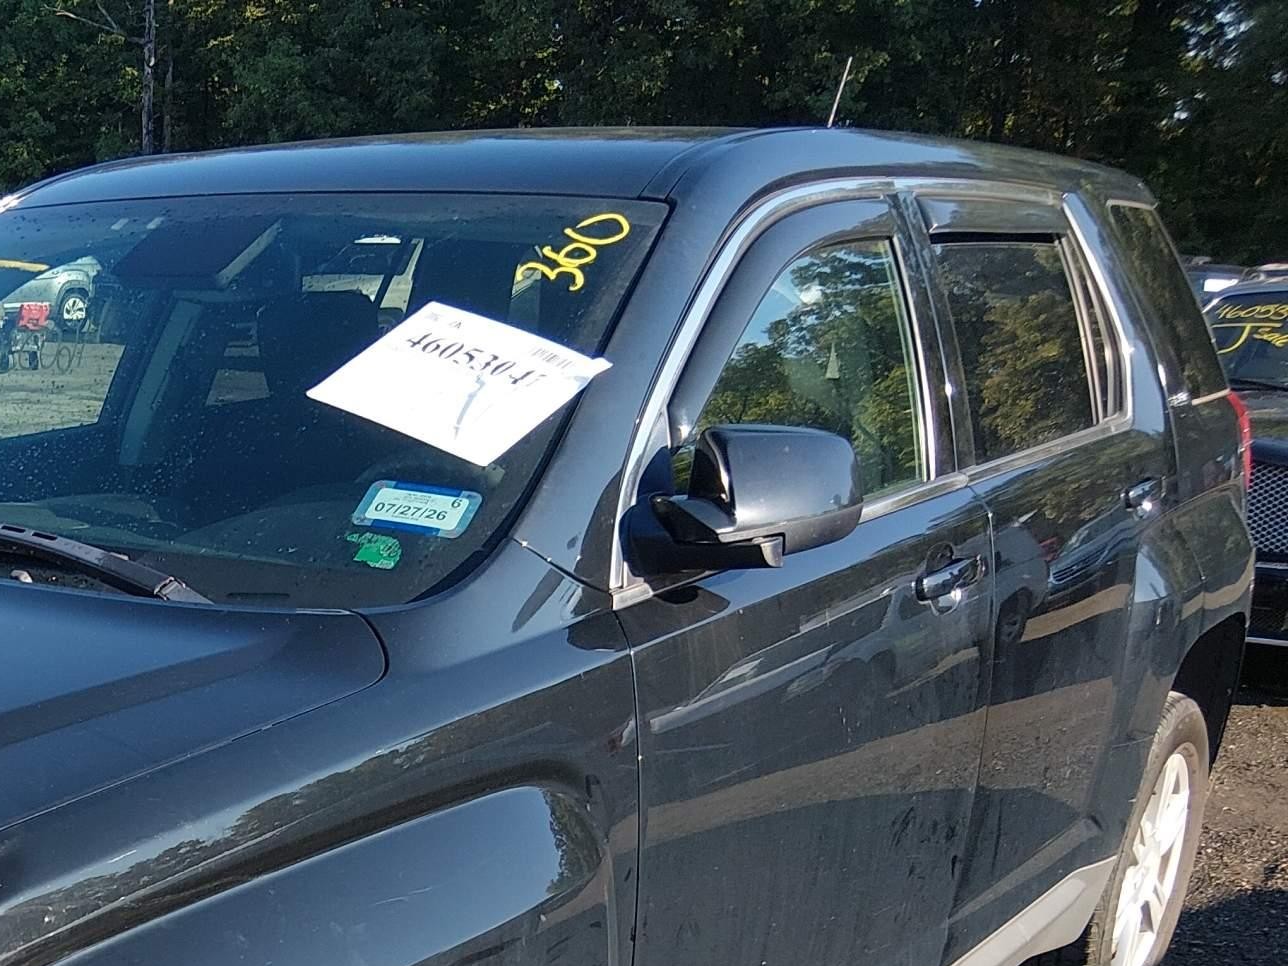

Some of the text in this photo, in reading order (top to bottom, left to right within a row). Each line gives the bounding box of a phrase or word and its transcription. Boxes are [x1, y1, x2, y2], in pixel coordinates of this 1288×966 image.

[517, 213, 630, 291] 360
[374, 501, 448, 521] 07/27/26
[450, 498, 463, 510] 6
